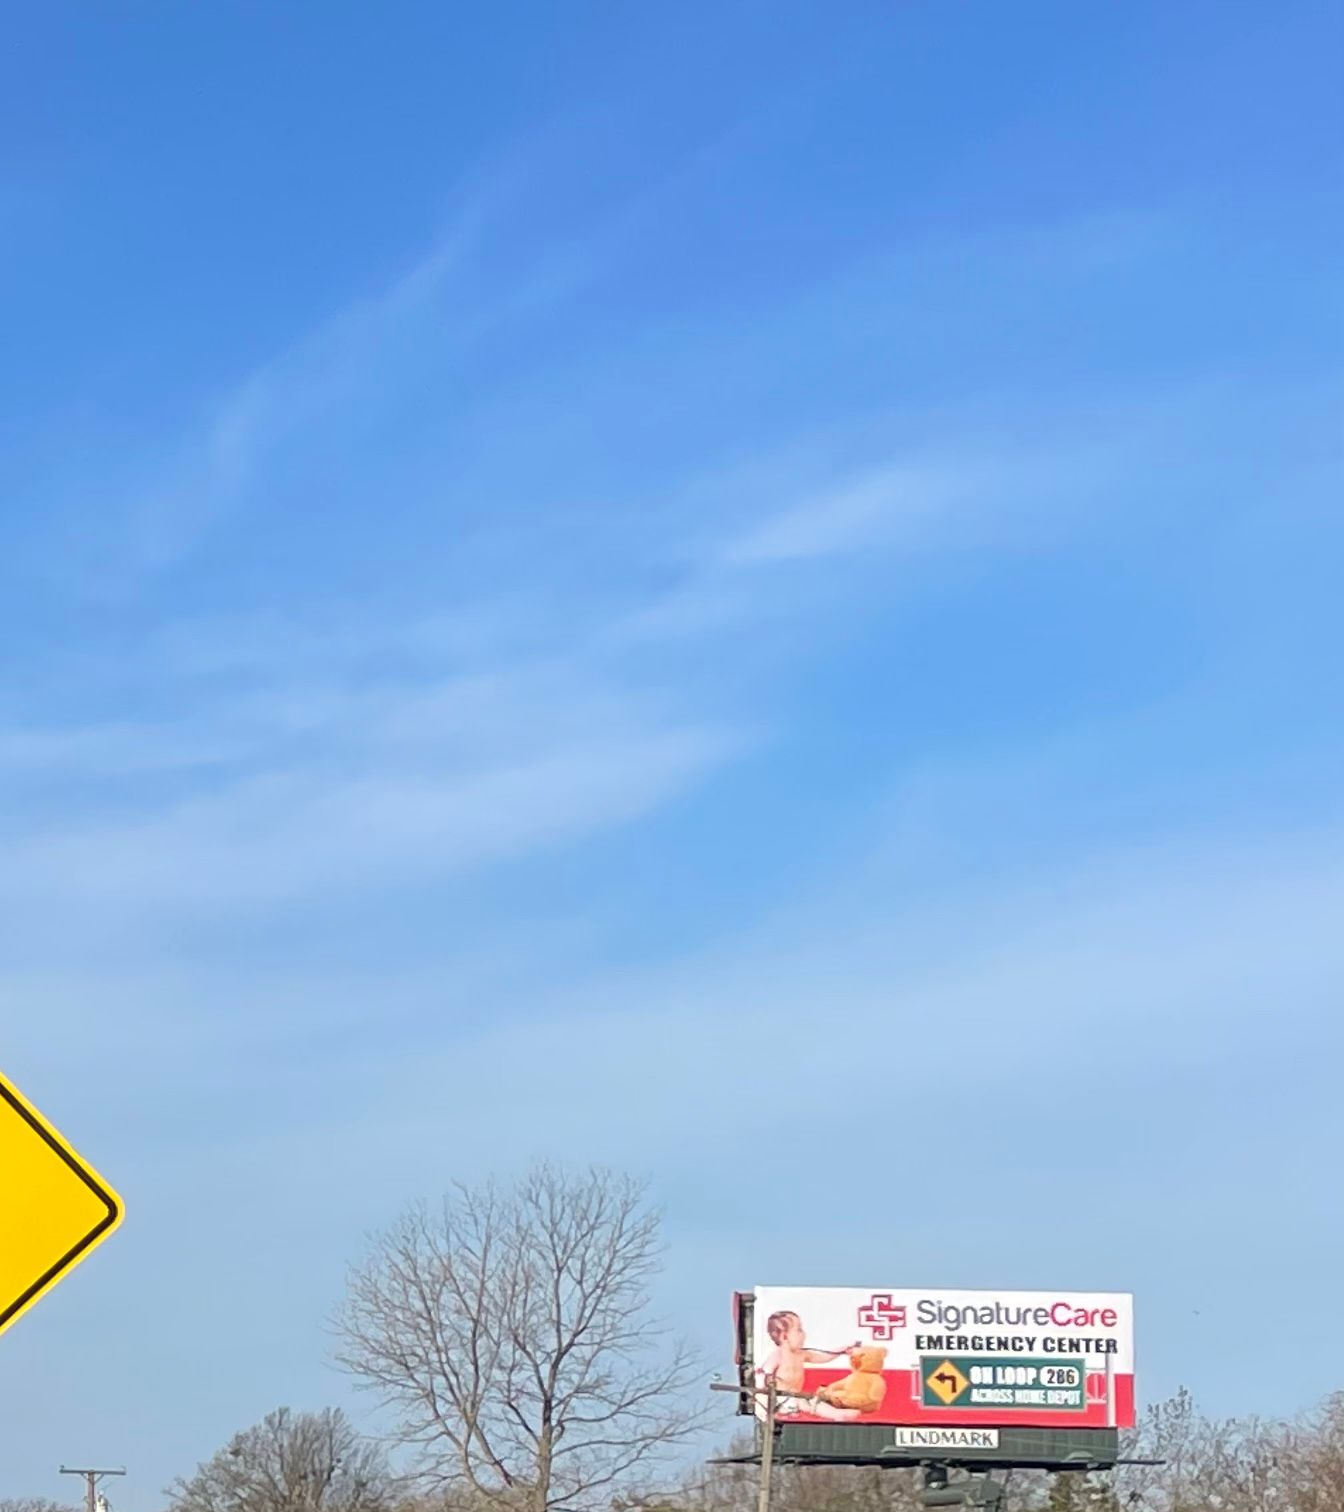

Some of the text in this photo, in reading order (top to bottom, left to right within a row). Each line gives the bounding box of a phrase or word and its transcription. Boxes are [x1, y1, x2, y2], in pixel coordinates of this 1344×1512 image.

[917, 1299, 1118, 1332] SignatureCare
[915, 1335, 1119, 1354] EMERGENCY CENTER
[969, 1366, 1076, 1386] ON LOOP 286
[1047, 1390, 1082, 1405] DEPOT
[899, 1430, 993, 1447] LINDMARK
